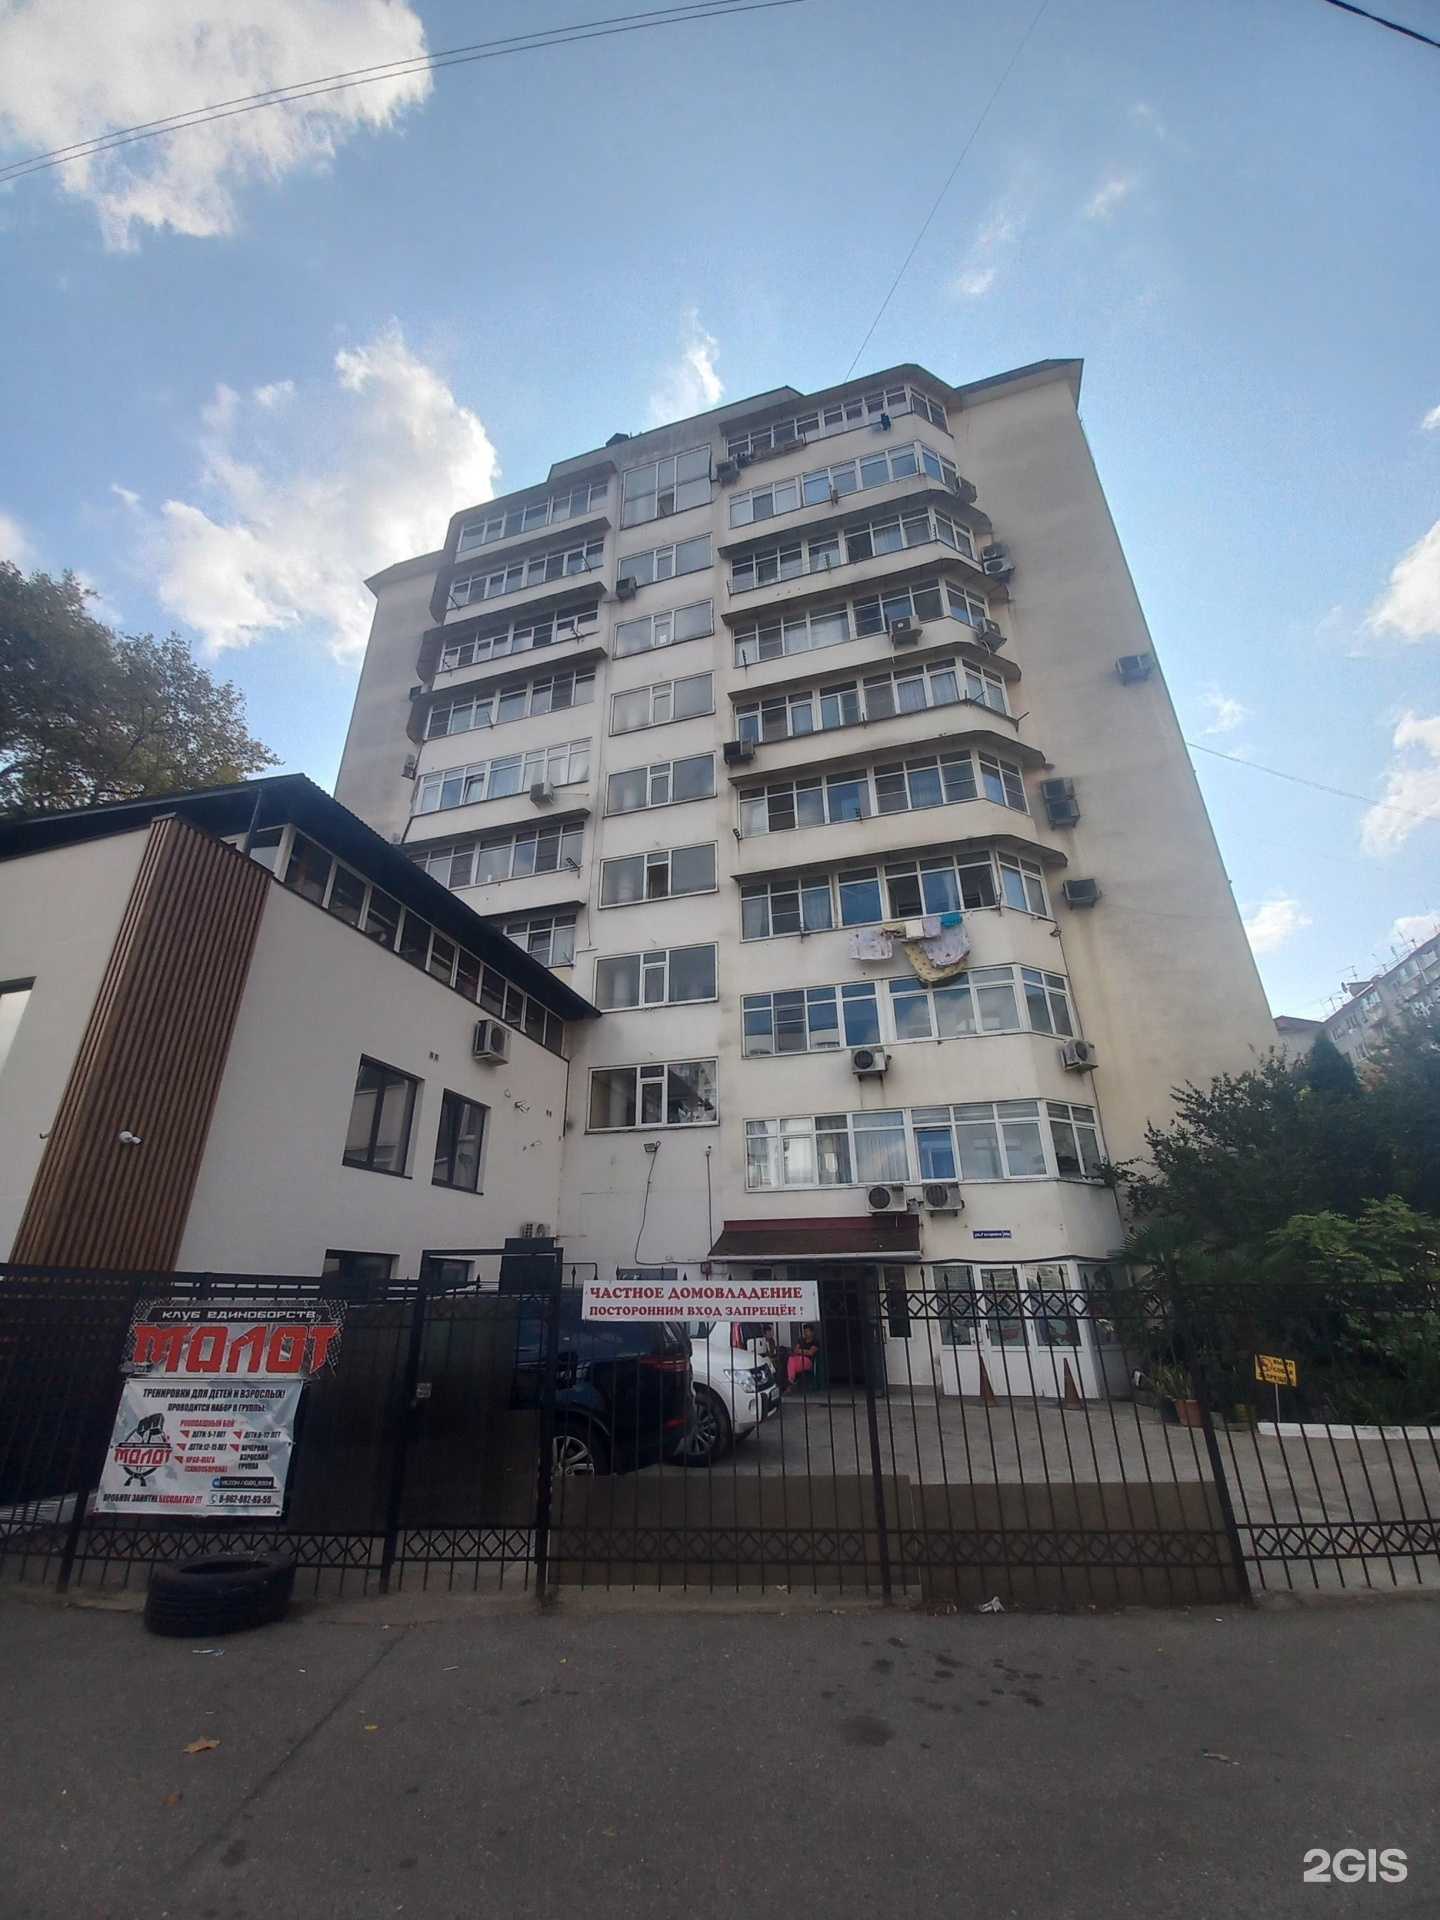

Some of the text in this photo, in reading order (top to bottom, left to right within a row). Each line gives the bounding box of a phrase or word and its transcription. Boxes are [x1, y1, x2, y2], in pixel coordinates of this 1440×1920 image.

[589, 1287, 803, 1300] ЧАСТНОЕ ДОМОВЛАДЕНИЕ
[162, 1311, 201, 1321] КЛУБ
[589, 1306, 684, 1316] ПОСТОРОННИМ
[686, 1306, 723, 1317] ВХОД
[725, 1304, 797, 1317] ЗАПРЕЩЁН
[133, 1326, 339, 1375] МОЛОТ
[143, 1388, 286, 1399] ТРЕНИРОВКИ ДЛЯ ДЕТЕЙ И ВЗРОСЛЫХ!
[168, 1403, 210, 1411] ПРОВОДИТСЯ
[210, 1403, 232, 1412] НАБОР
[115, 1449, 172, 1464] МОЛОТ
[158, 1494, 194, 1504] БЕСПЛАТНО
